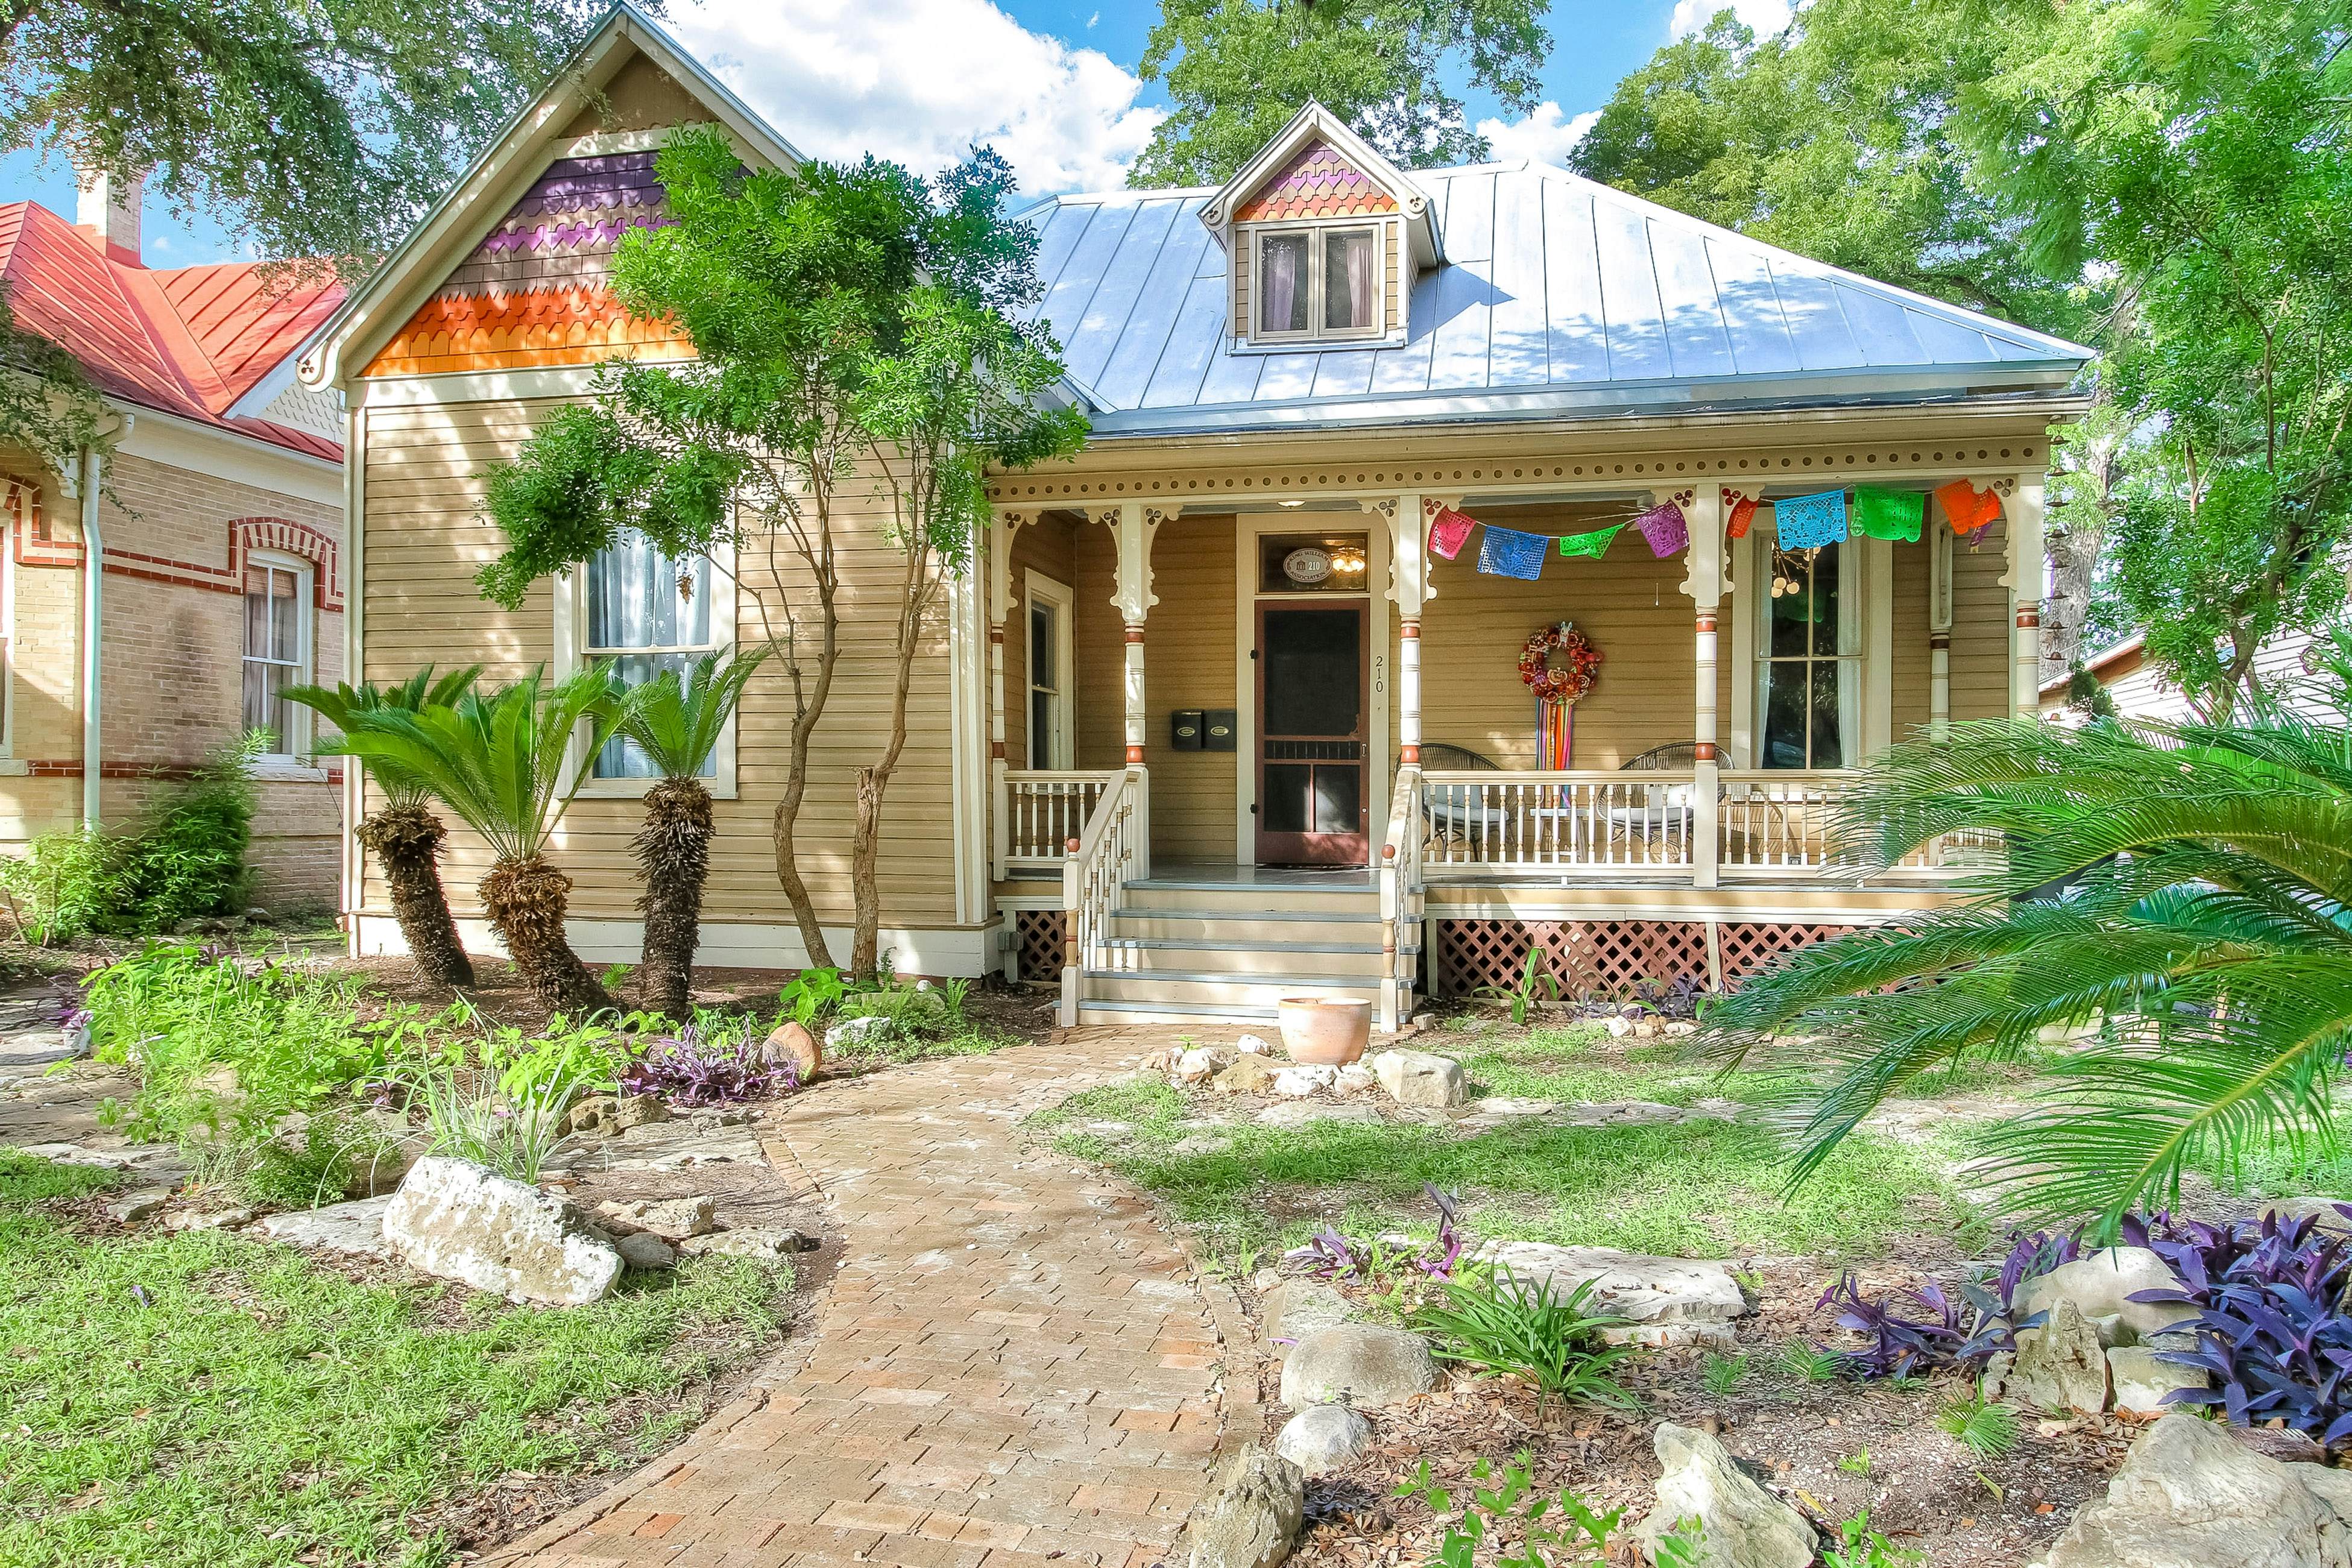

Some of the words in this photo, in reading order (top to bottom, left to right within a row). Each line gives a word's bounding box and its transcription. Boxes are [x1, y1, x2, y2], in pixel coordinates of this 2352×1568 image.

[1289, 553, 1303, 561] KING
[1305, 551, 1329, 561] WILLIAM
[1308, 561, 1320, 570] 210
[1290, 571, 1326, 579] ASSOCIATION
